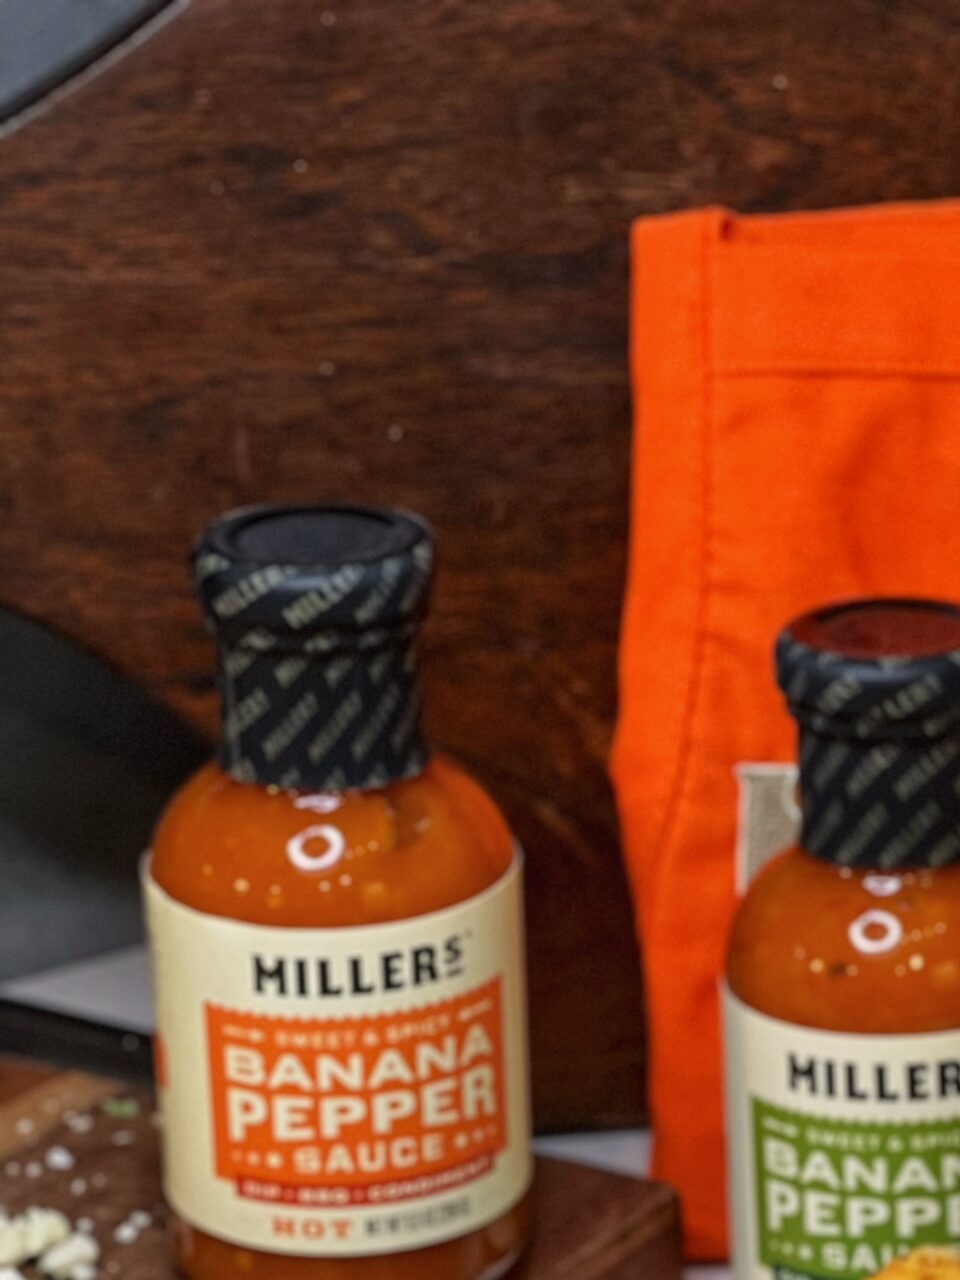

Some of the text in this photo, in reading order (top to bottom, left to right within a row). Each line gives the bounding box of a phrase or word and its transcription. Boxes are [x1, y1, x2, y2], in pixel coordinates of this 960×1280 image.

[252, 934, 465, 997] MILLERS
[223, 1024, 493, 1092] BANANA
[227, 1063, 497, 1143] PEPPER
[293, 1133, 446, 1175] SAUCE
[272, 1216, 352, 1239] HOT
